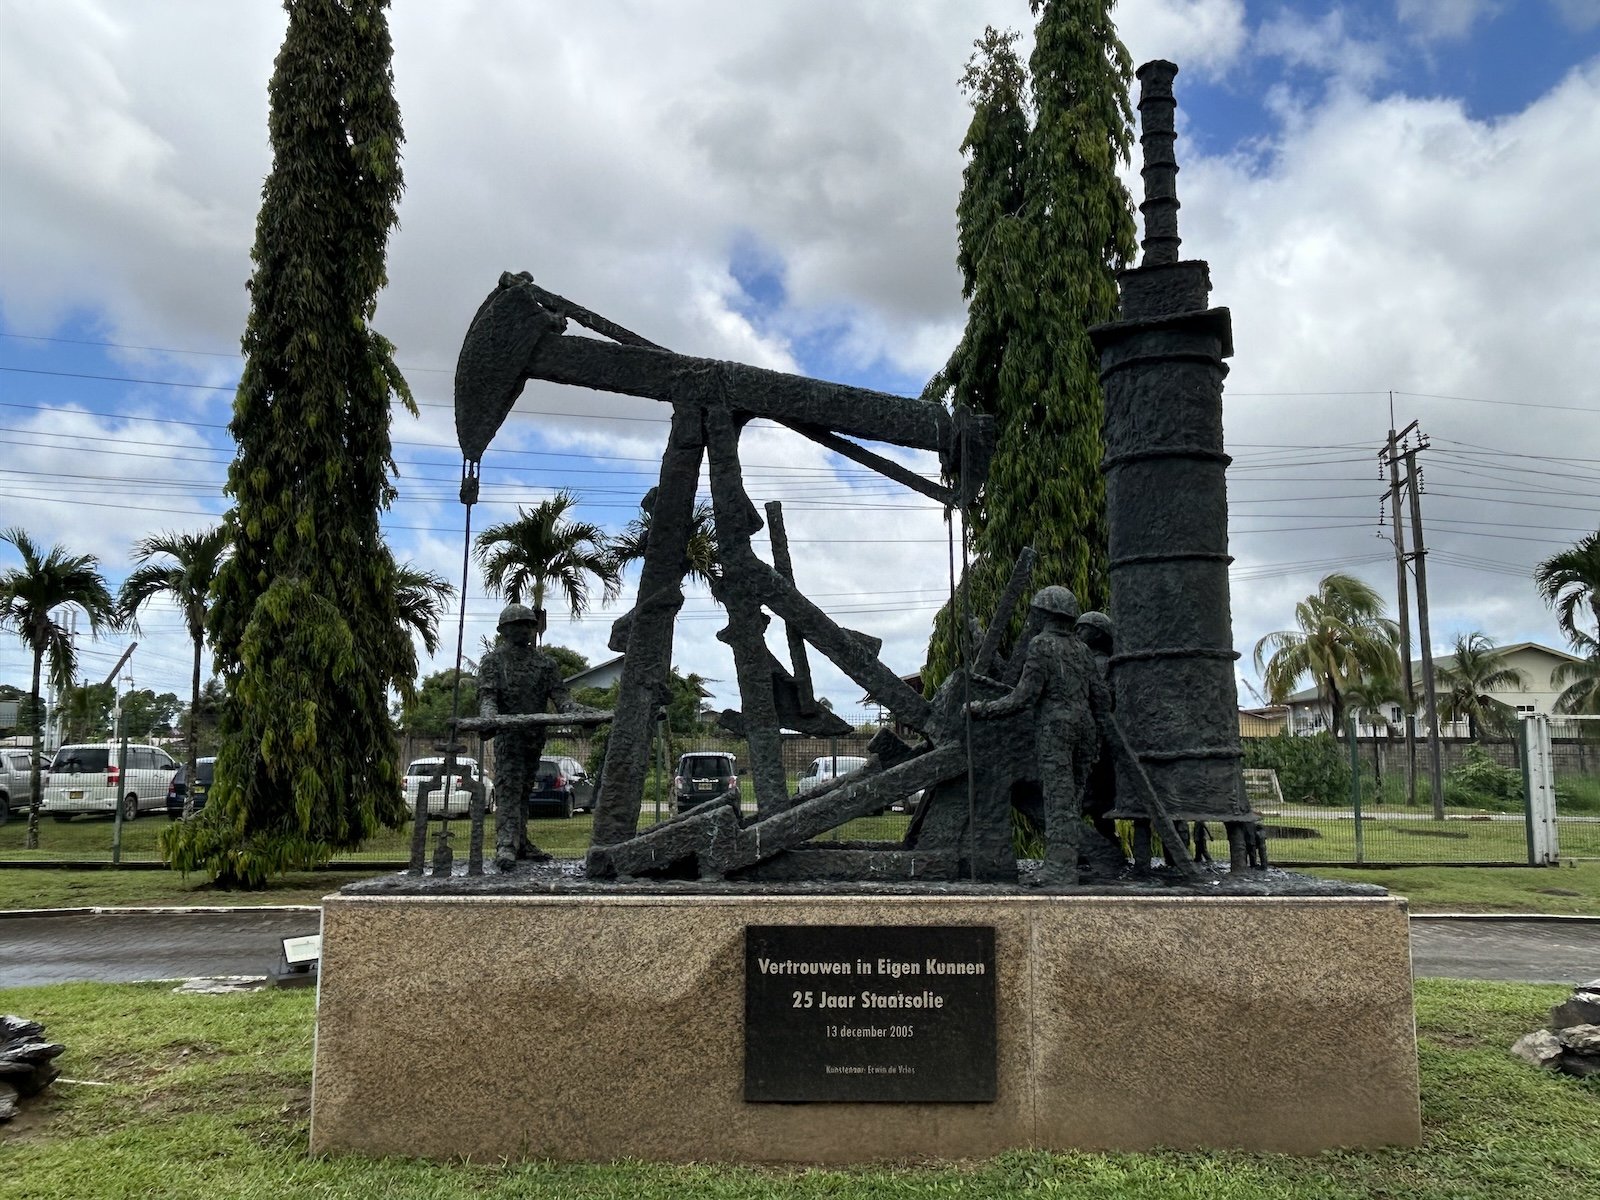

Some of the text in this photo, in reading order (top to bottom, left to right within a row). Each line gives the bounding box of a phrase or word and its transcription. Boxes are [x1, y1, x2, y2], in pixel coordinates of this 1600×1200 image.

[757, 957, 985, 979] Vertrouwen in Eigen Kunnen
[792, 990, 944, 1009] 25 Jaar Staatsolie
[826, 1025, 914, 1038] 13 december 2005
[888, 1064, 897, 1074] de
